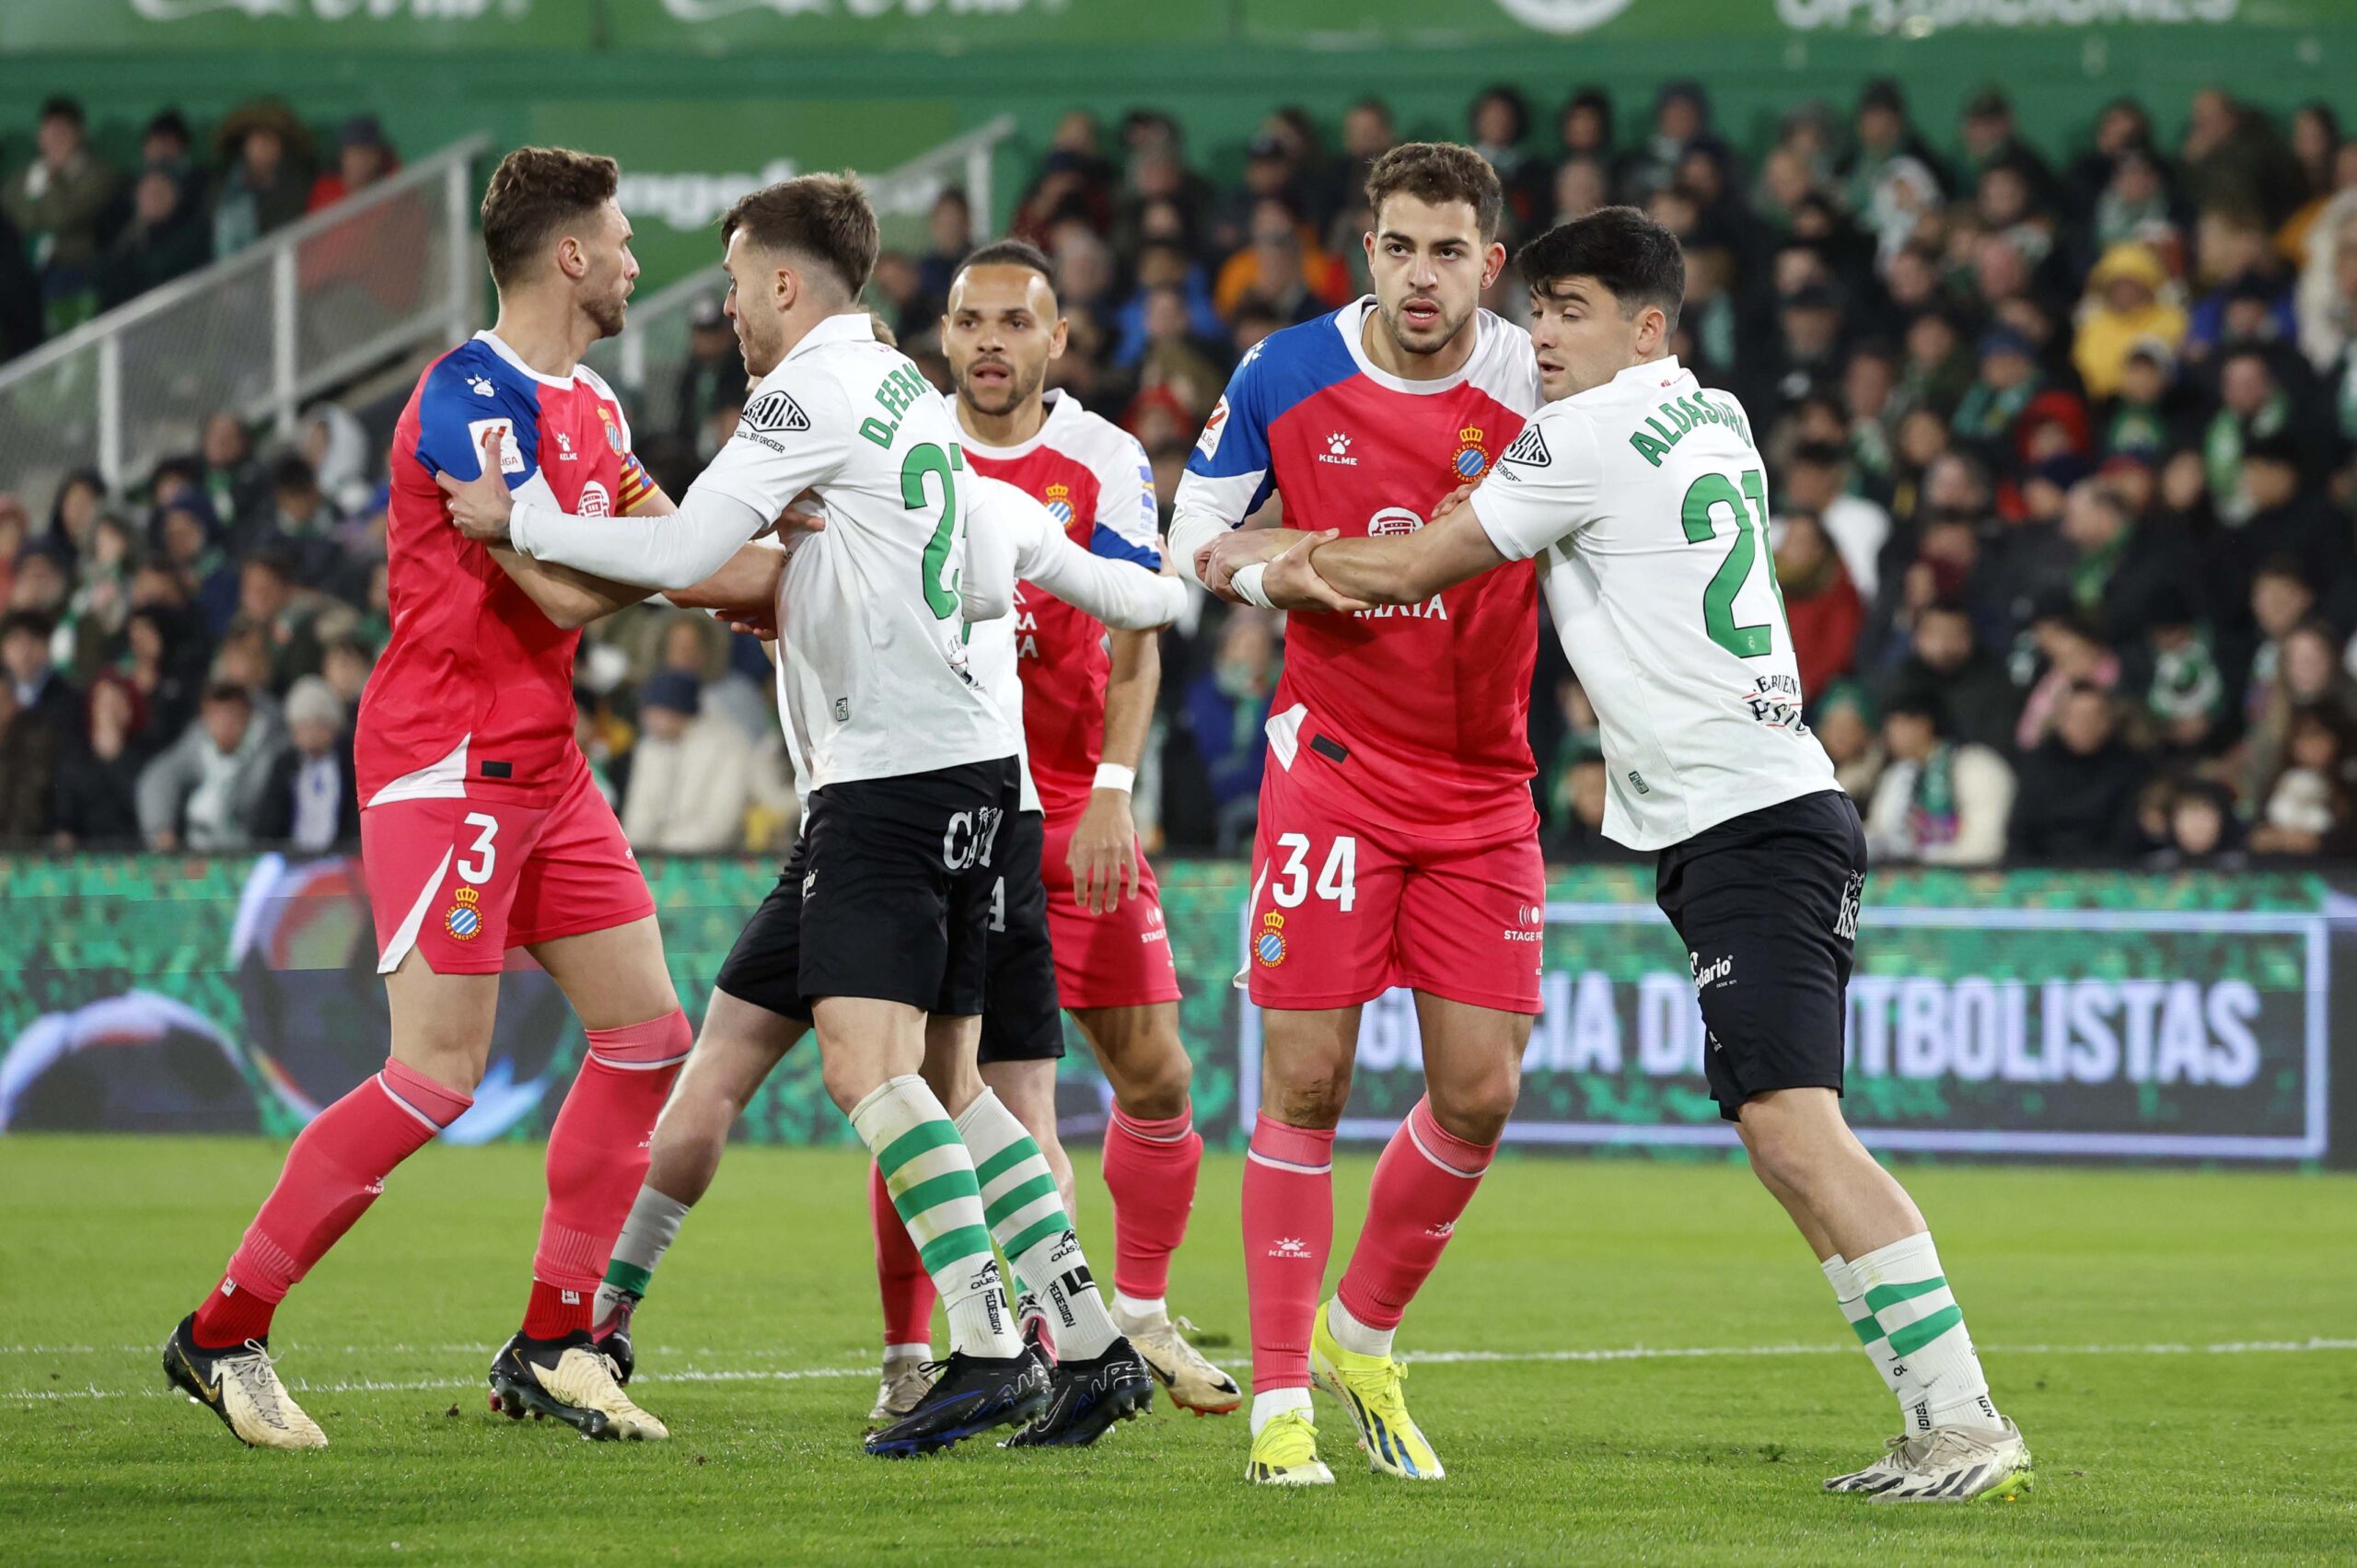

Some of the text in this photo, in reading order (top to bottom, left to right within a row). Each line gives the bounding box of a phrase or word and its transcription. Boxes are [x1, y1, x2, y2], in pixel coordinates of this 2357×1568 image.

[749, 432, 785, 454] BURGER
[1461, 443, 1491, 462] ESPANYOL
[1318, 453, 1358, 466] KELME
[458, 812, 499, 885] 3
[1271, 832, 1357, 912] 34
[1504, 930, 1536, 942] STAGE
[1268, 1249, 1311, 1259] KELME
